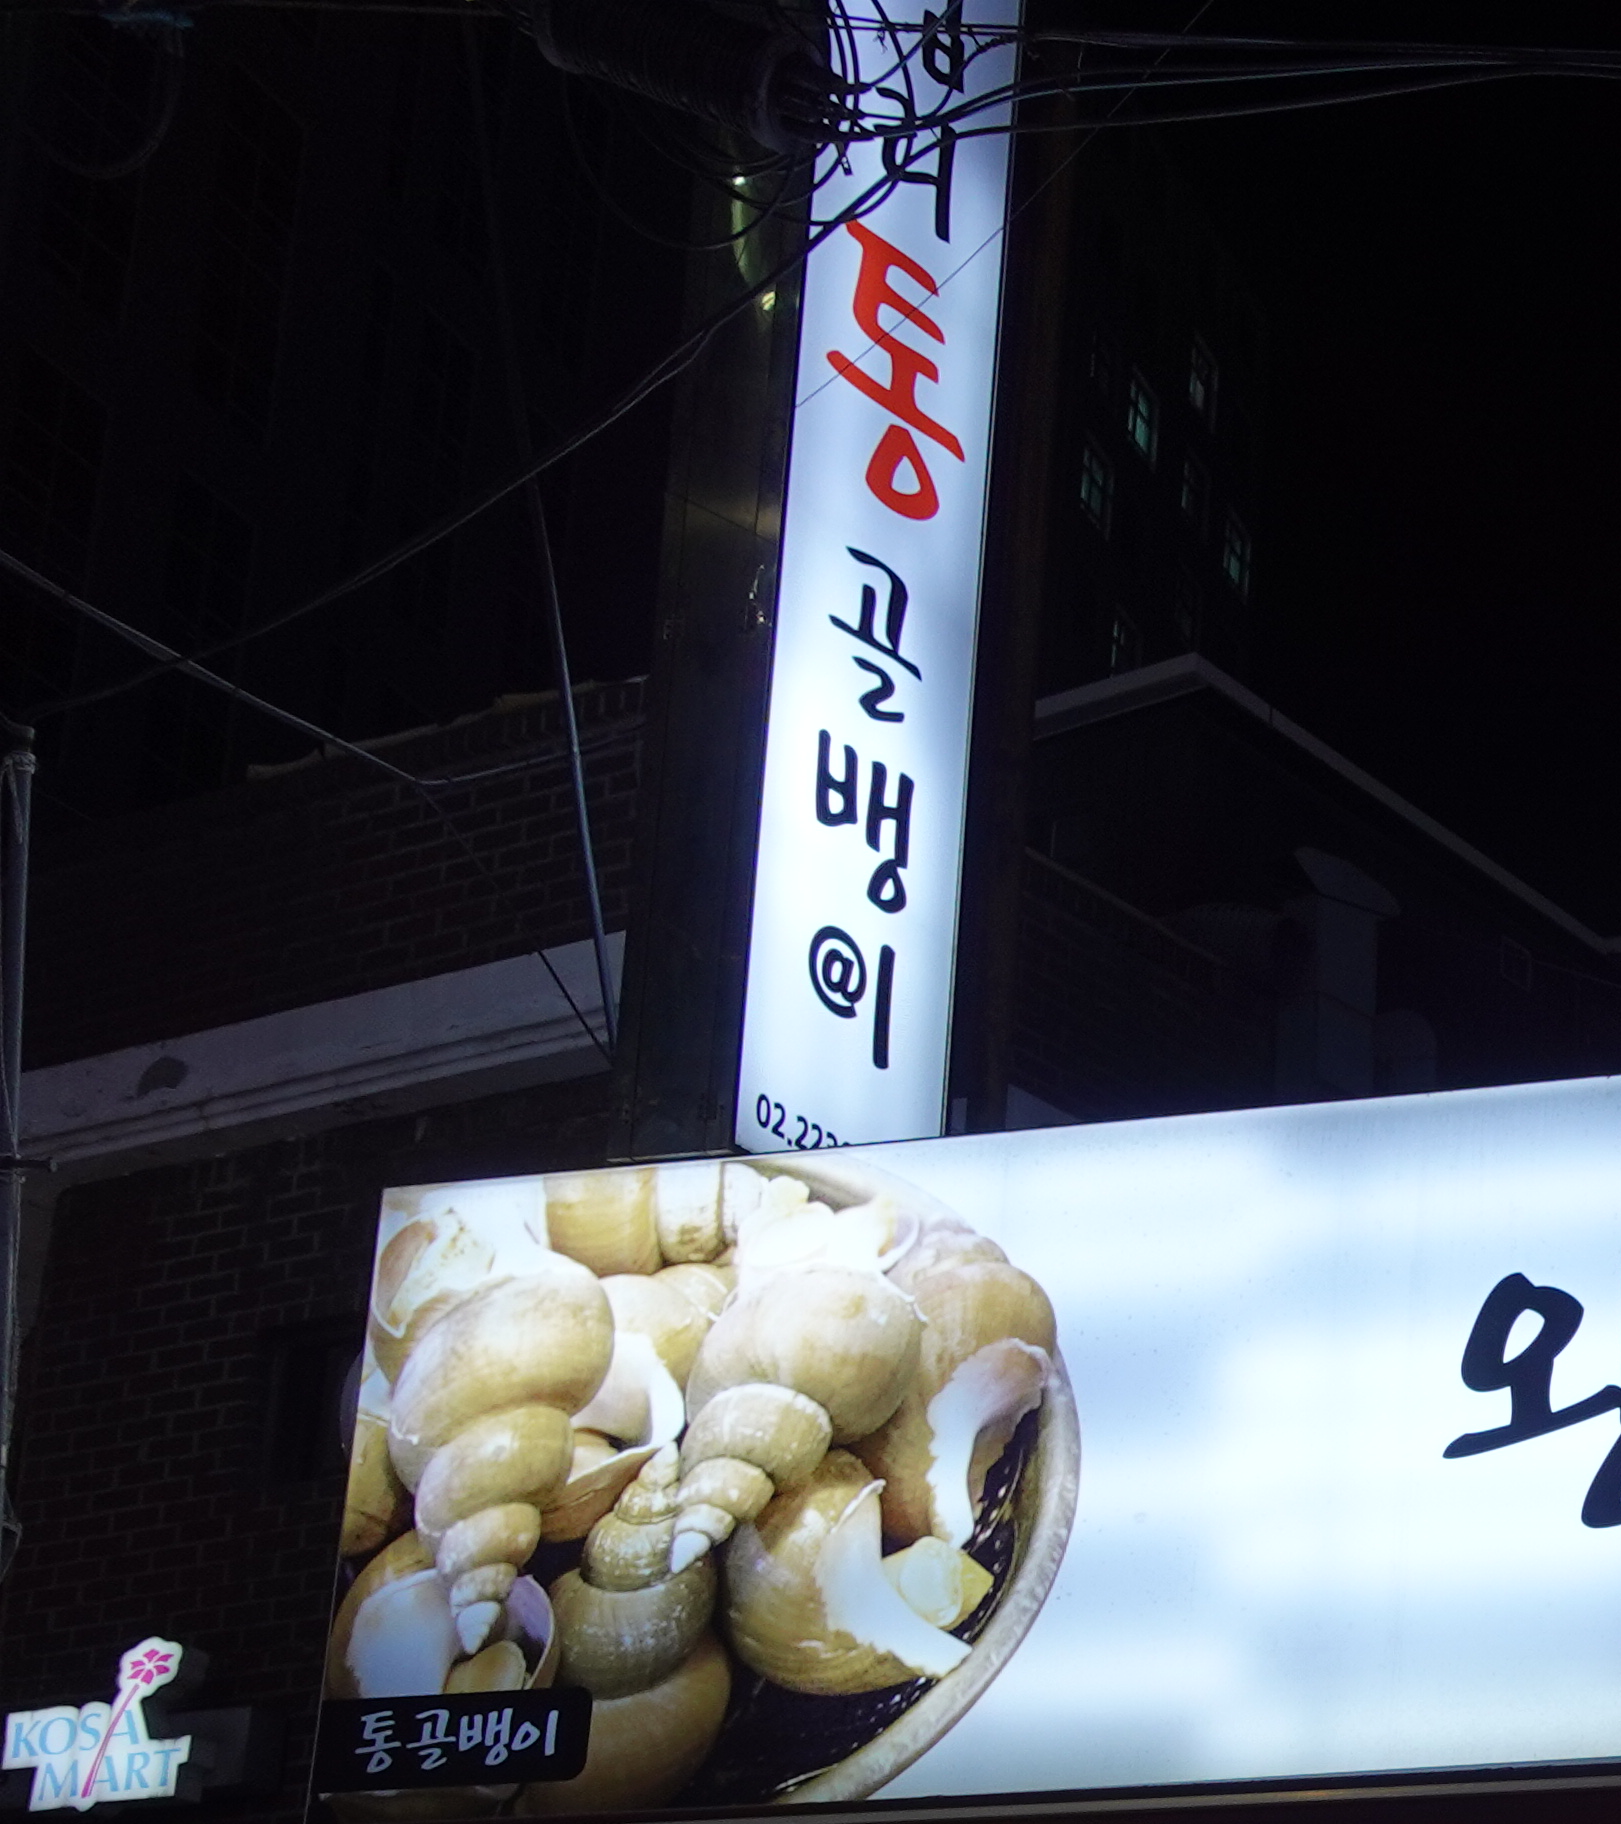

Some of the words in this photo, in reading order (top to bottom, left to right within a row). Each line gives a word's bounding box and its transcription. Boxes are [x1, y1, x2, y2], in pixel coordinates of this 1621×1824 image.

[756, 1093, 852, 1150] 02.22
[11, 1706, 140, 1758] KOSA
[355, 1707, 559, 1774] 통골뱅이
[38, 1746, 183, 1800] MART
